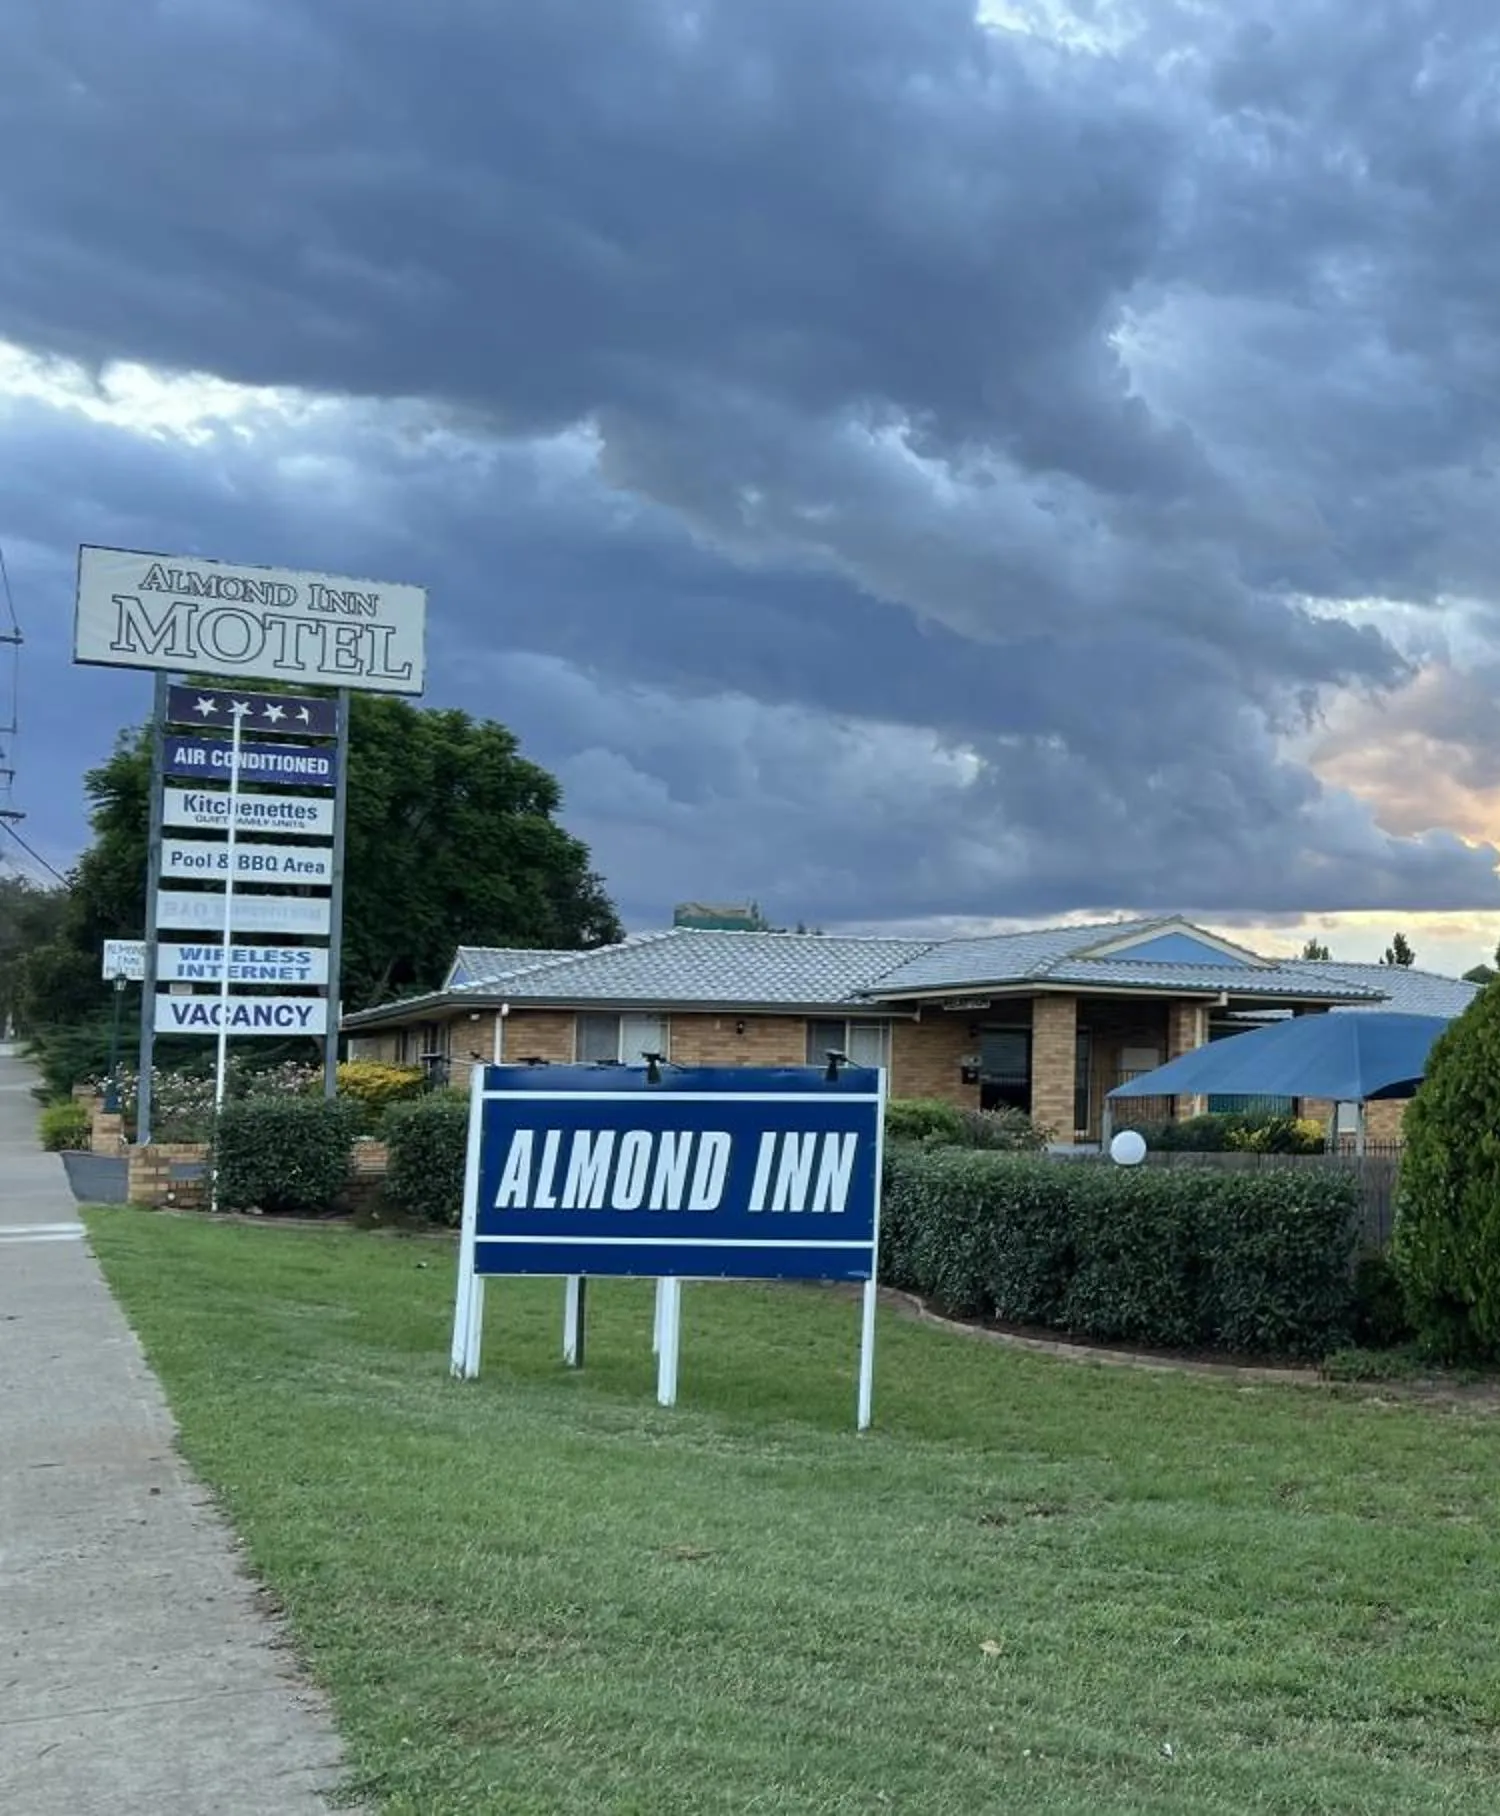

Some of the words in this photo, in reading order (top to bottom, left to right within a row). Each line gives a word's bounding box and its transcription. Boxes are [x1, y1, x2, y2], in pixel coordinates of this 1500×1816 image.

[139, 564, 298, 607] ALMOND
[308, 584, 379, 616] INN
[110, 595, 412, 680] MOTEL
[174, 747, 206, 765] AIR
[211, 750, 329, 775] CONDITIONED
[171, 851, 211, 868] Pool
[217, 853, 229, 869] &
[238, 855, 278, 871] BBQ
[283, 857, 325, 874] Area
[177, 964, 311, 980] INTERNET
[171, 1003, 313, 1027] VACANCY
[493, 1129, 733, 1211] ALMOND
[747, 1131, 860, 1212] INN
